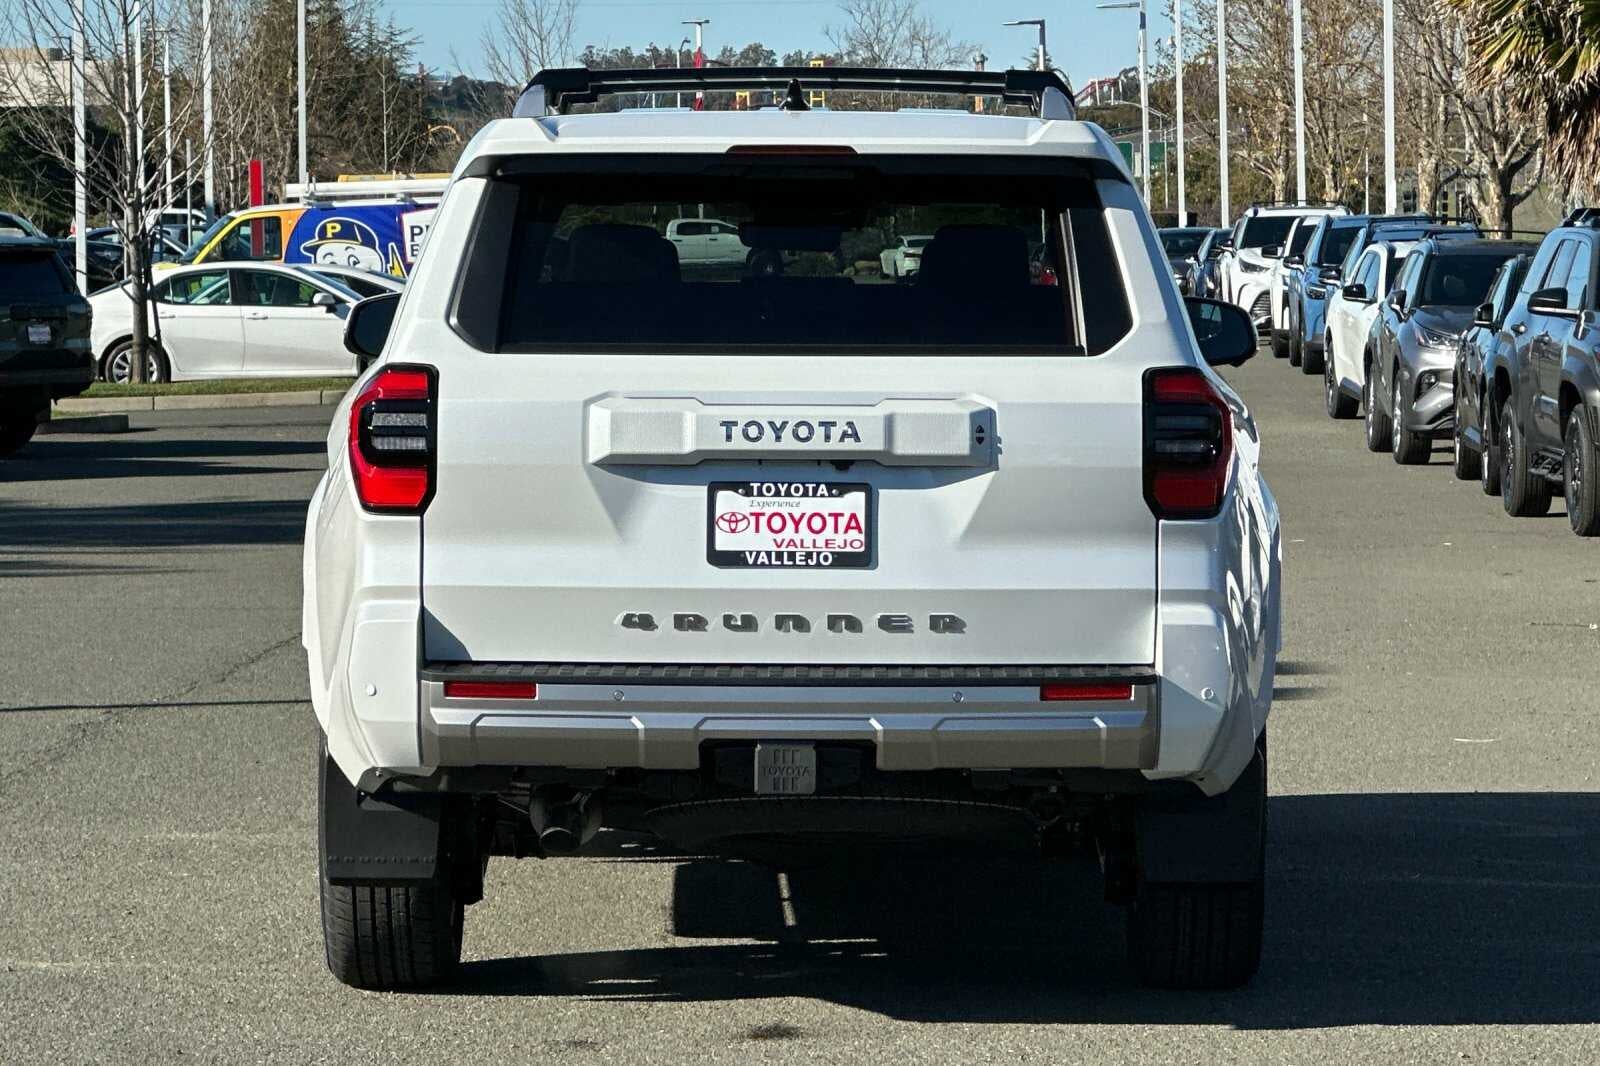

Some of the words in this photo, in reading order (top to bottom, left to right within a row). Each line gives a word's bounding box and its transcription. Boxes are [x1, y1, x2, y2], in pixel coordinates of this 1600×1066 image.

[325, 222, 341, 238] P
[719, 420, 862, 443] TOYOTA
[750, 483, 829, 497] TOYOTA
[750, 500, 801, 509] Experience
[749, 512, 864, 535] TOYOTA
[772, 538, 864, 550] VALLEJO
[745, 551, 833, 566] VALLEJO
[760, 766, 810, 777] TOYOTA
